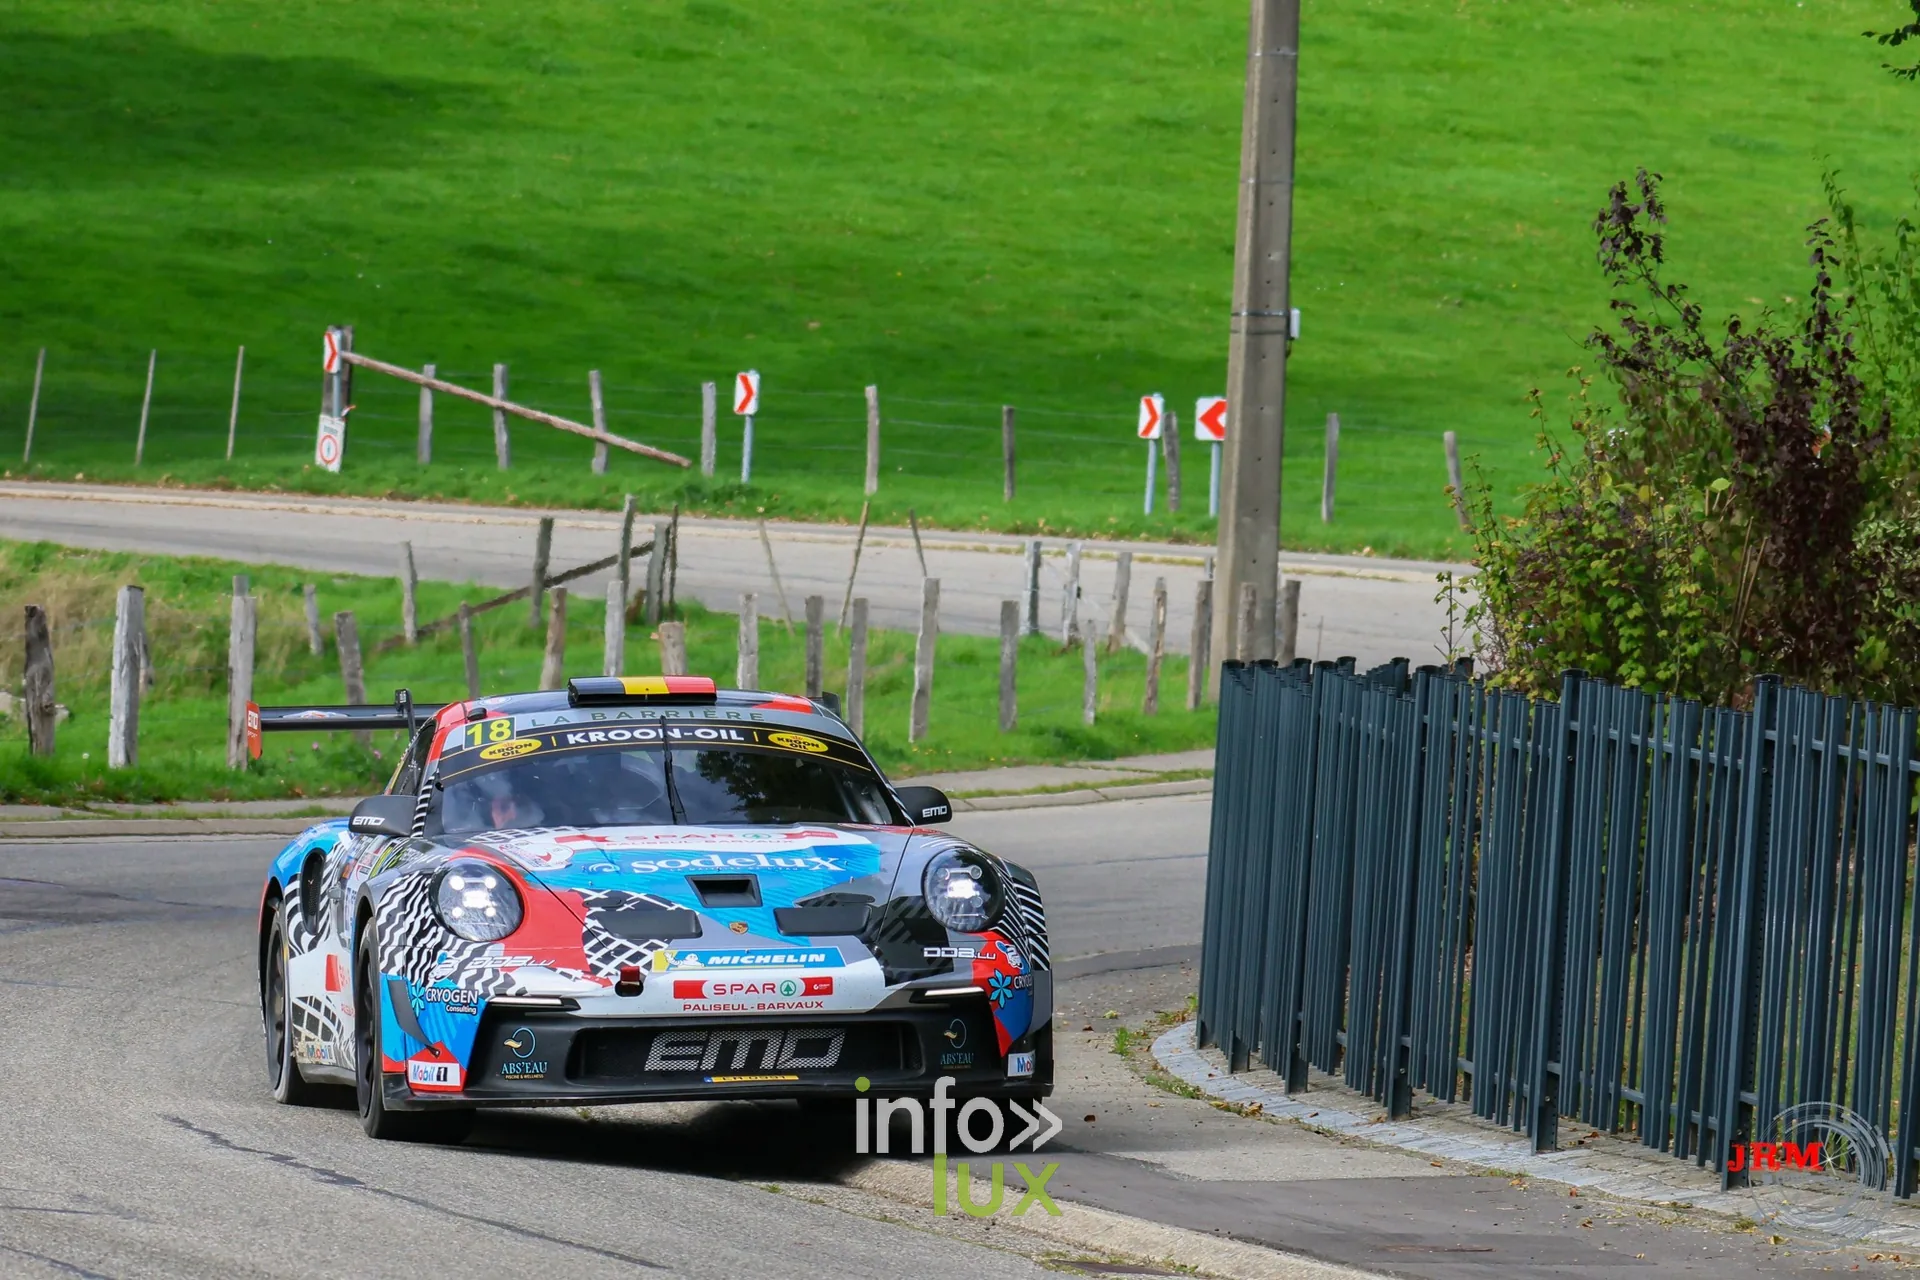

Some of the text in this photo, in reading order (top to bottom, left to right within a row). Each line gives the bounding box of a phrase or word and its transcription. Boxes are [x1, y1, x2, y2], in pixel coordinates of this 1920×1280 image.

[532, 708, 765, 728] LA BARRIÈRE
[466, 719, 512, 746] 18
[566, 728, 745, 745] KROON-OIL
[488, 742, 533, 756] KROON
[777, 737, 820, 749] KROON
[789, 743, 809, 751] OIL
[501, 748, 521, 757] OIL
[631, 854, 846, 873] sodelux
[708, 953, 826, 965] MICHELIN
[425, 988, 479, 1004] CRYOGEN
[713, 983, 777, 996] SPAR
[446, 1004, 477, 1015] Consulting
[412, 1064, 448, 1081] Mobil 1
[501, 1061, 548, 1075] ABS'EAU
